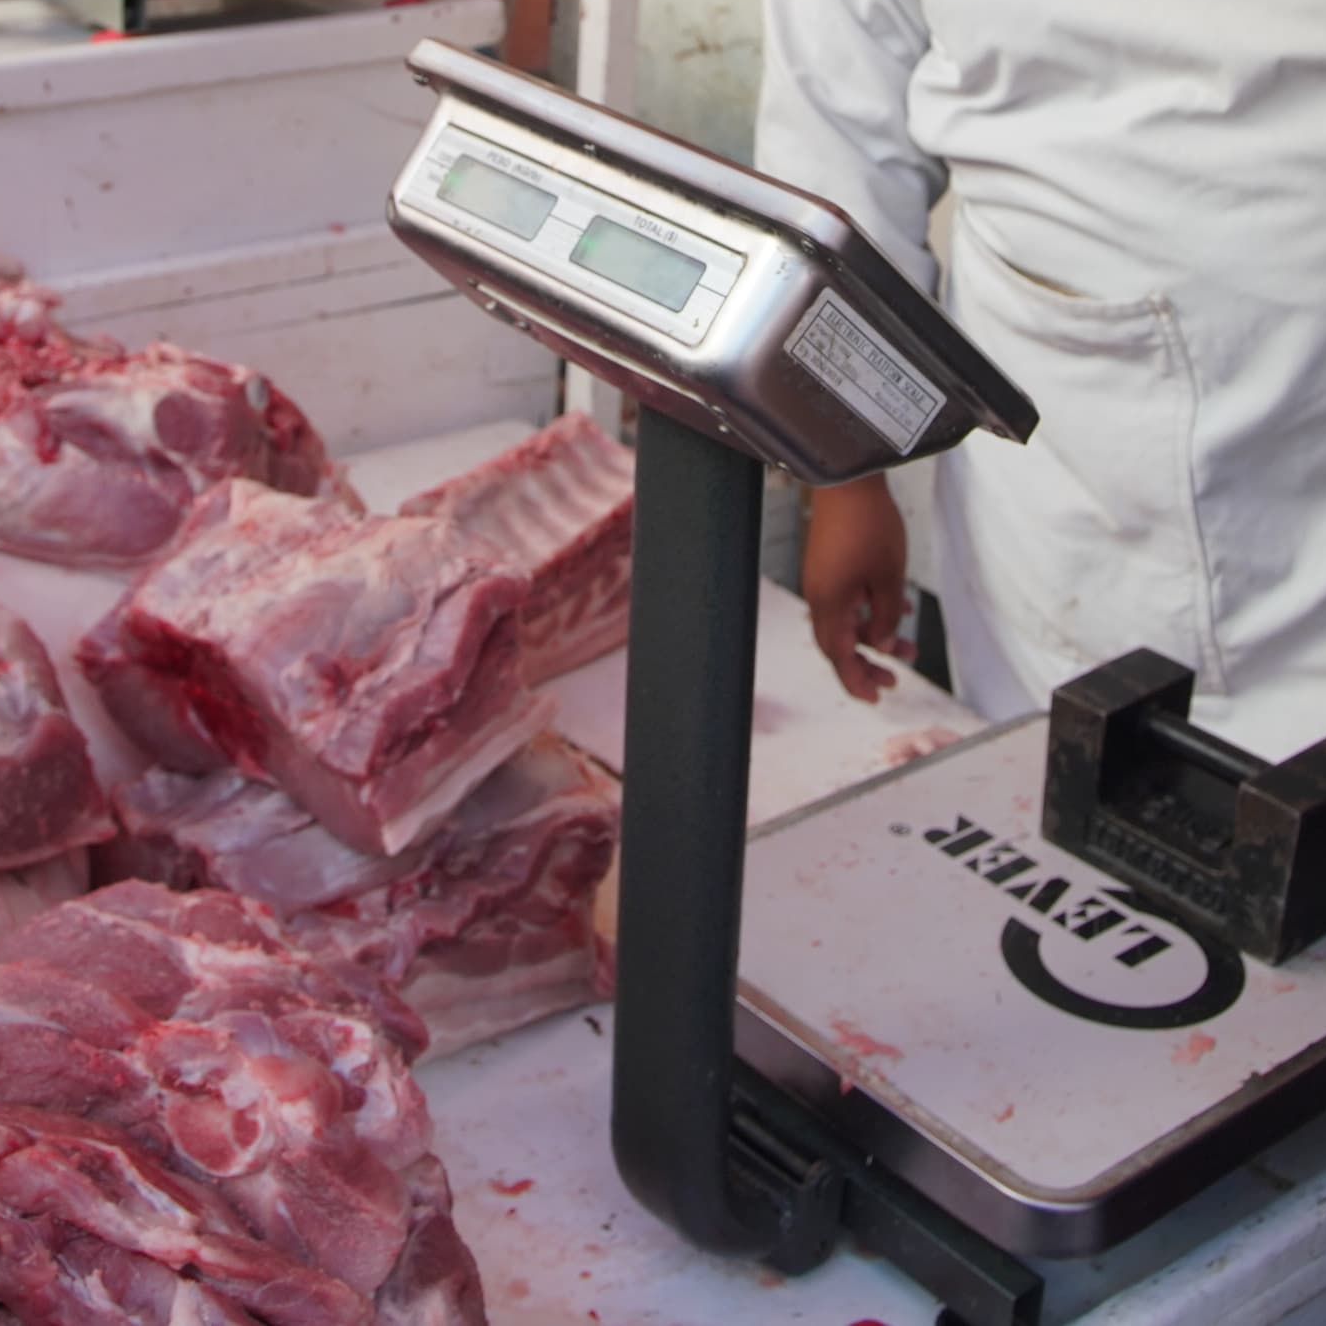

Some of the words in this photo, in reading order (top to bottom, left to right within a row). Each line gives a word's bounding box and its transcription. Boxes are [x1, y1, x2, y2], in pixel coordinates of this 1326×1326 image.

[634, 216, 664, 237] TOTAL
[826, 311, 868, 353] ELECTRONIC
[903, 380, 927, 403] SCALE
[923, 815, 1172, 968] LEVER
